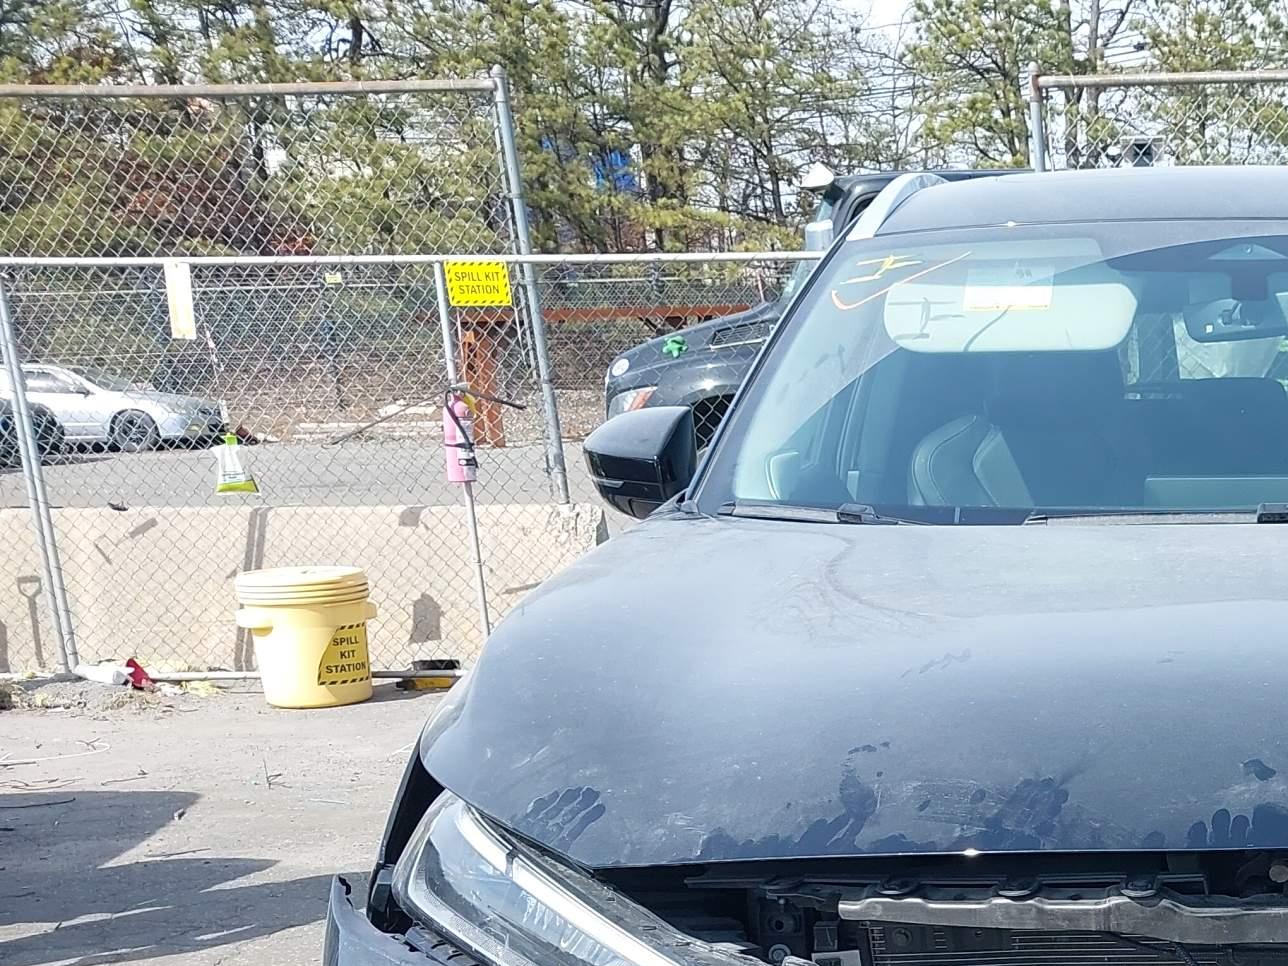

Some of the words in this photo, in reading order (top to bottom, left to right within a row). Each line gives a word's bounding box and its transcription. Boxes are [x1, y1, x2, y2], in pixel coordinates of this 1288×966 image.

[454, 271, 482, 282] SPILL
[485, 271, 500, 282] KIT
[458, 284, 500, 295] STATION
[332, 635, 360, 647] SPILL
[339, 649, 356, 660] KIT
[325, 661, 367, 674] STATION
